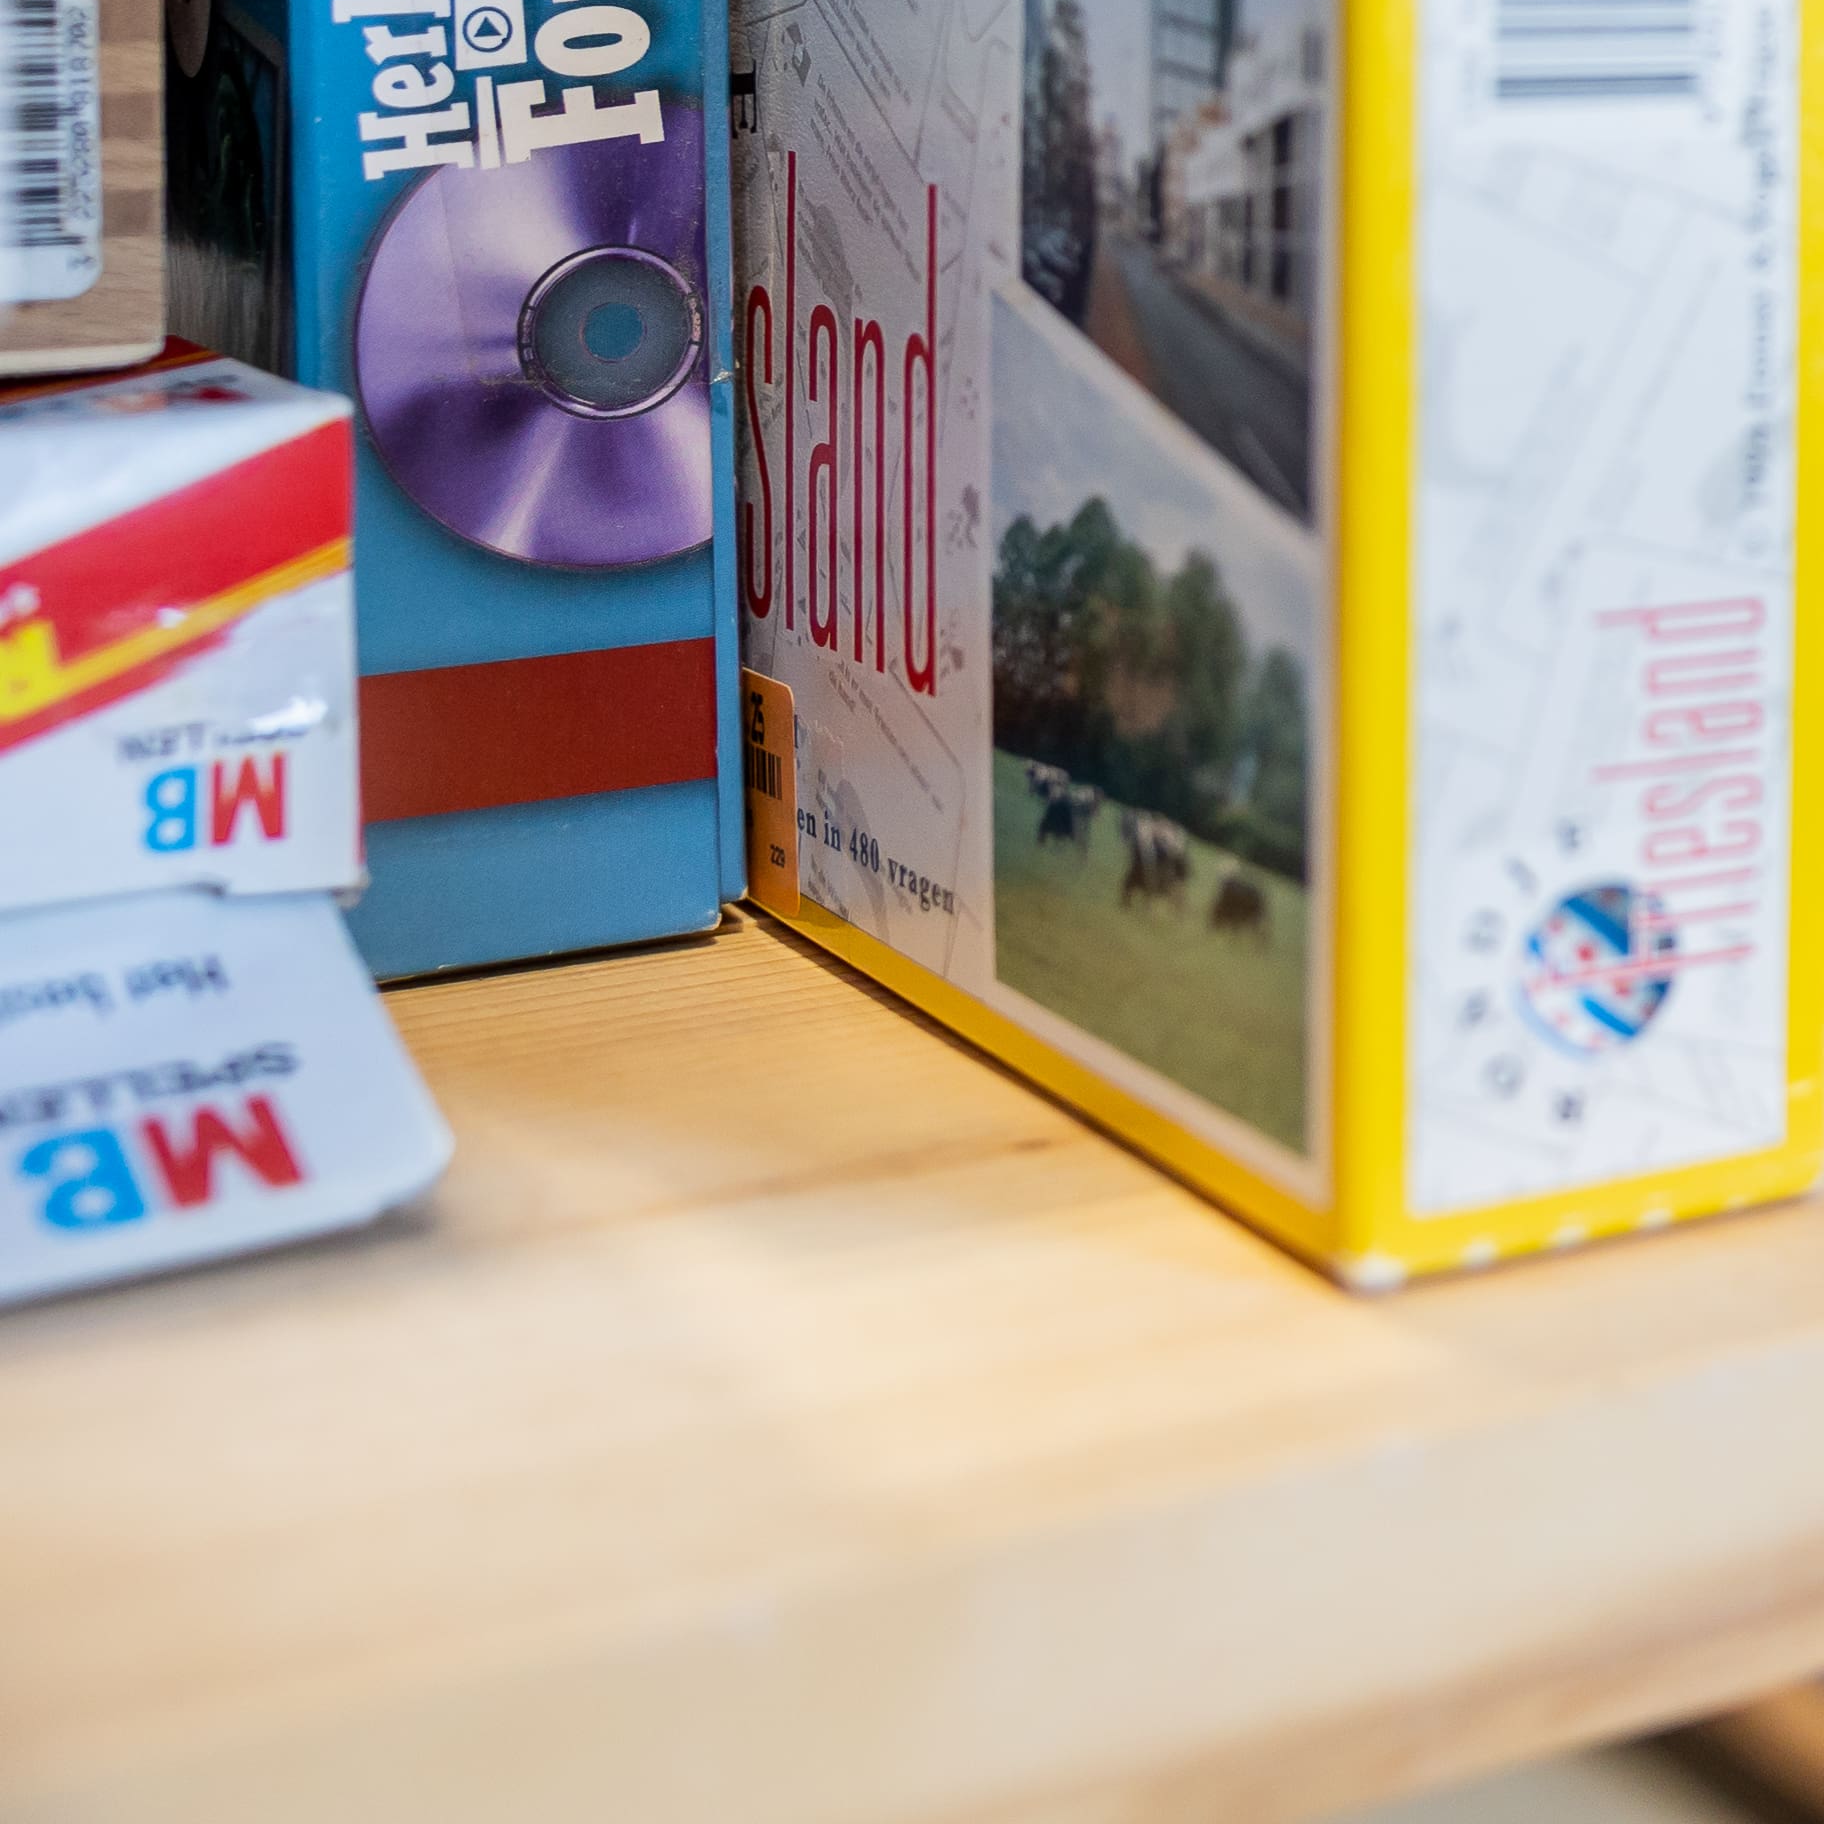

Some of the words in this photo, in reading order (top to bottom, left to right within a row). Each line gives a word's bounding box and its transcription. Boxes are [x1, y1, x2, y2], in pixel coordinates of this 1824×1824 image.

[745, 150, 937, 697] sland
[751, 692, 764, 744] 25
[141, 752, 290, 855] MB
[797, 807, 816, 840] en
[824, 811, 841, 852] in
[848, 828, 880, 873] 480
[888, 860, 955, 915] vragen
[19, 1096, 307, 1232] MB
